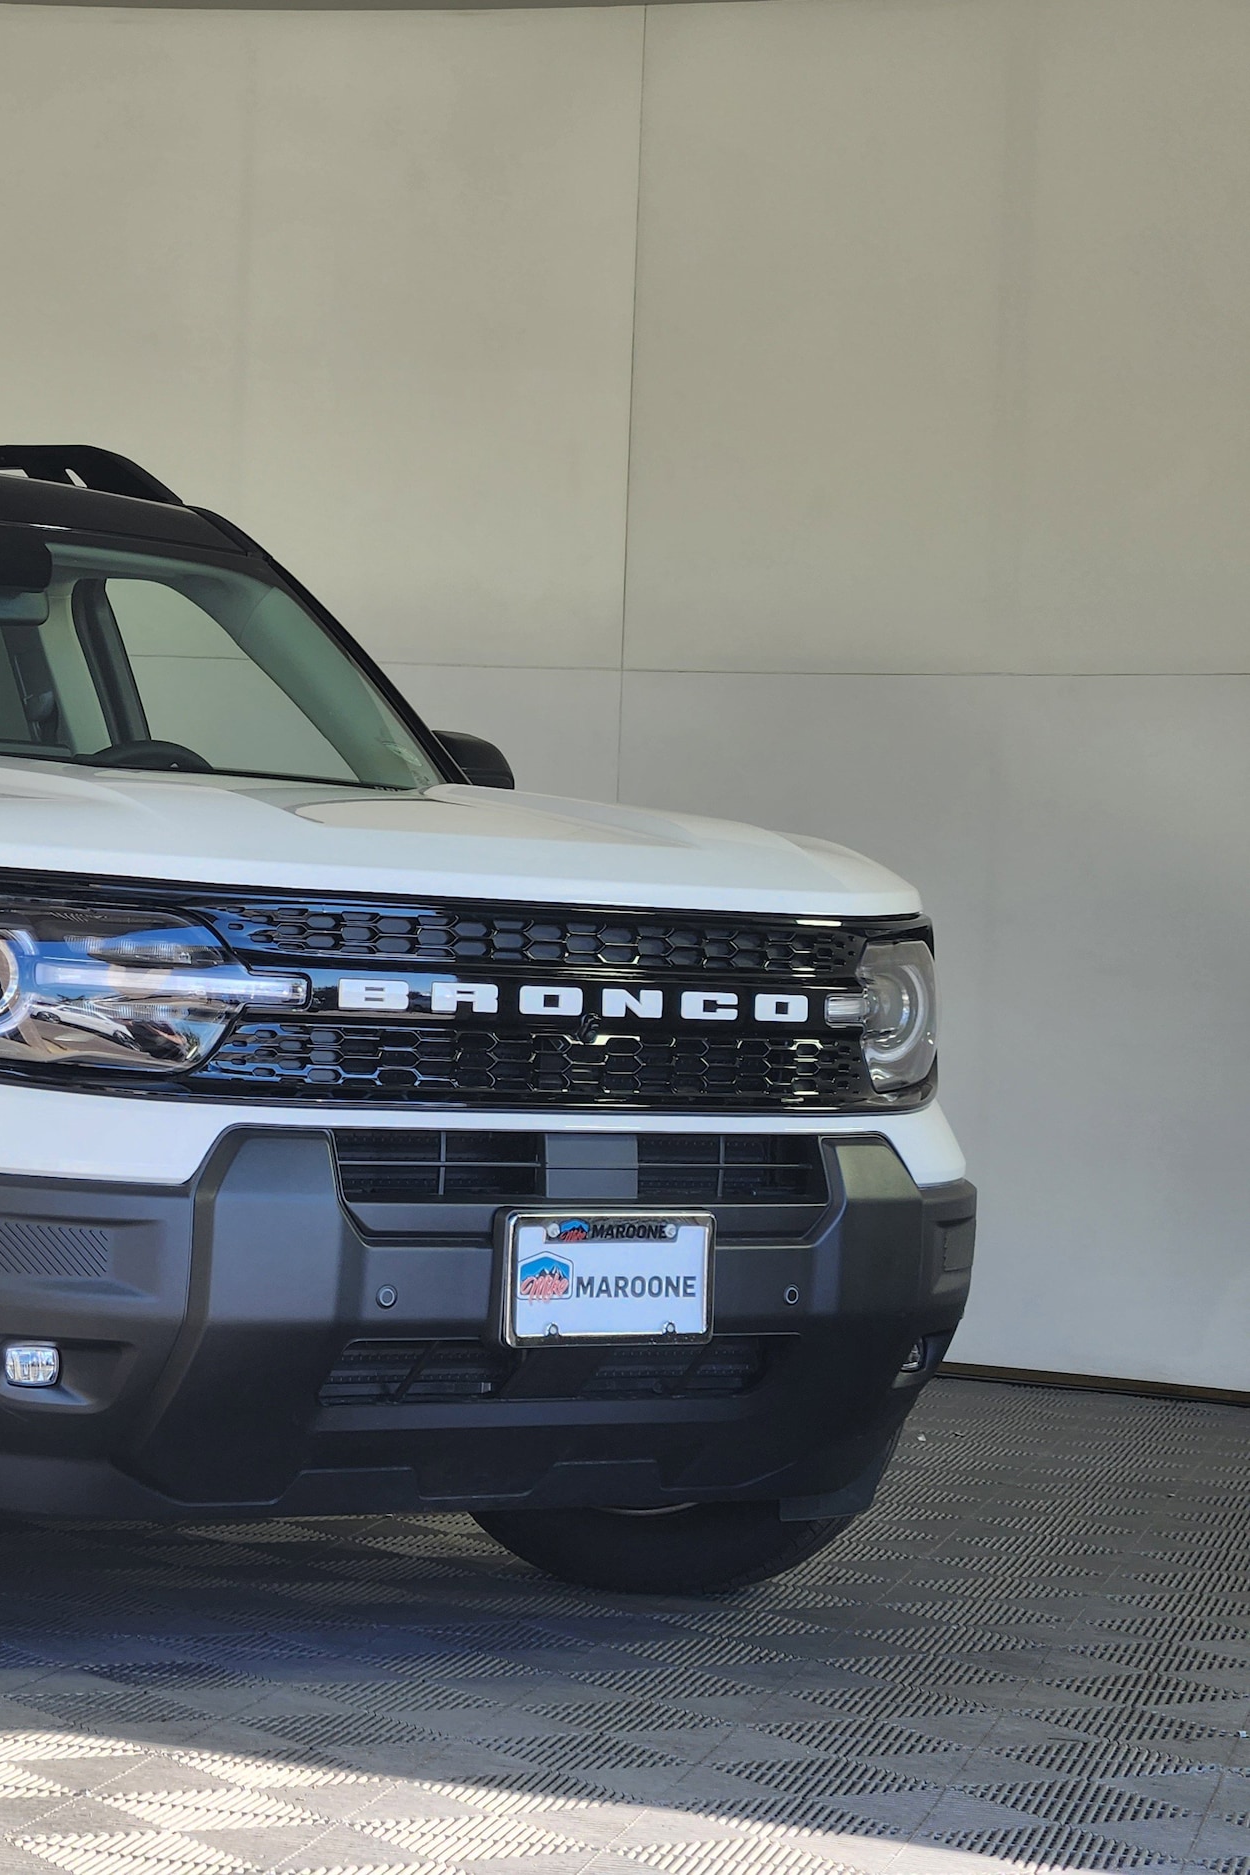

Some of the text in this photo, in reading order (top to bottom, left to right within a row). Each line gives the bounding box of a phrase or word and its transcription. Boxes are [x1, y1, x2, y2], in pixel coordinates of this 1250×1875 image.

[337, 978, 810, 1022] BRONCO
[591, 1224, 667, 1239] MAROONE
[520, 1273, 697, 1306] Mike MAROONE
